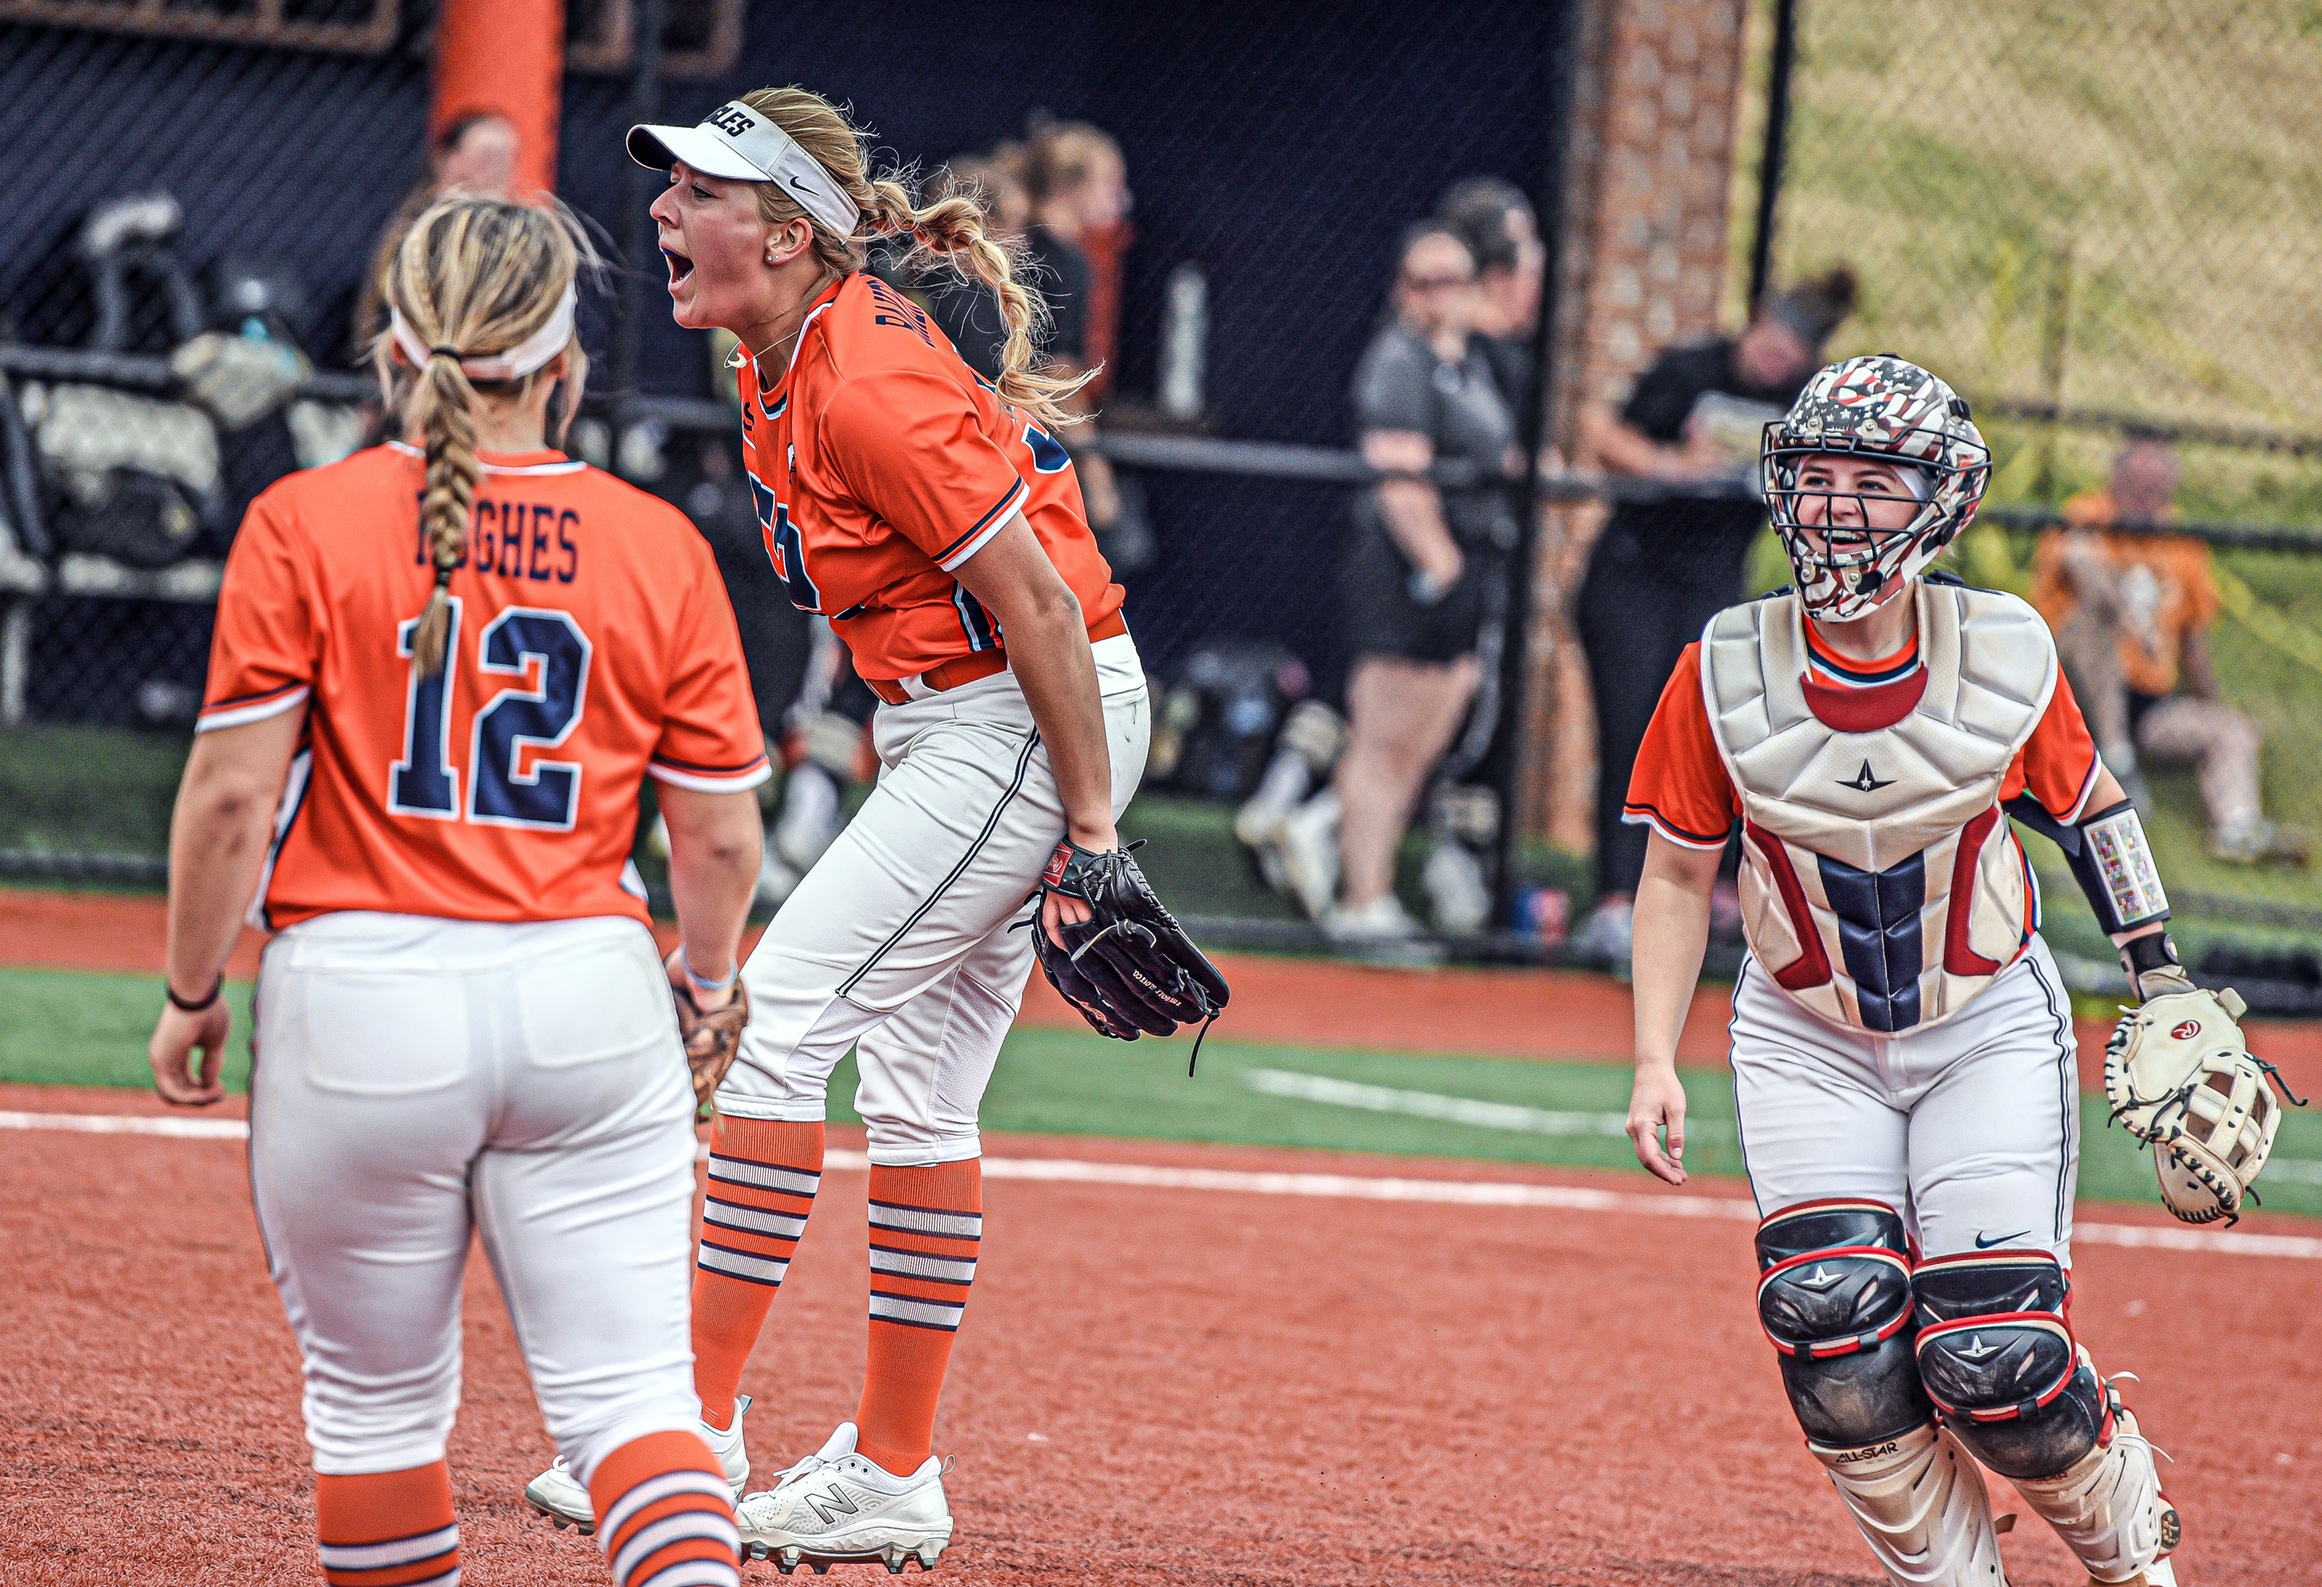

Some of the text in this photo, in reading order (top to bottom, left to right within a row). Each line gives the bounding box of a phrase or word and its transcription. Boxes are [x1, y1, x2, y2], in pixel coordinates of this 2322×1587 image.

[416, 491, 580, 584] GHES
[386, 596, 593, 833] 12
[1835, 1441, 1899, 1464] ALL-STAR
[804, 1482, 859, 1525] N
